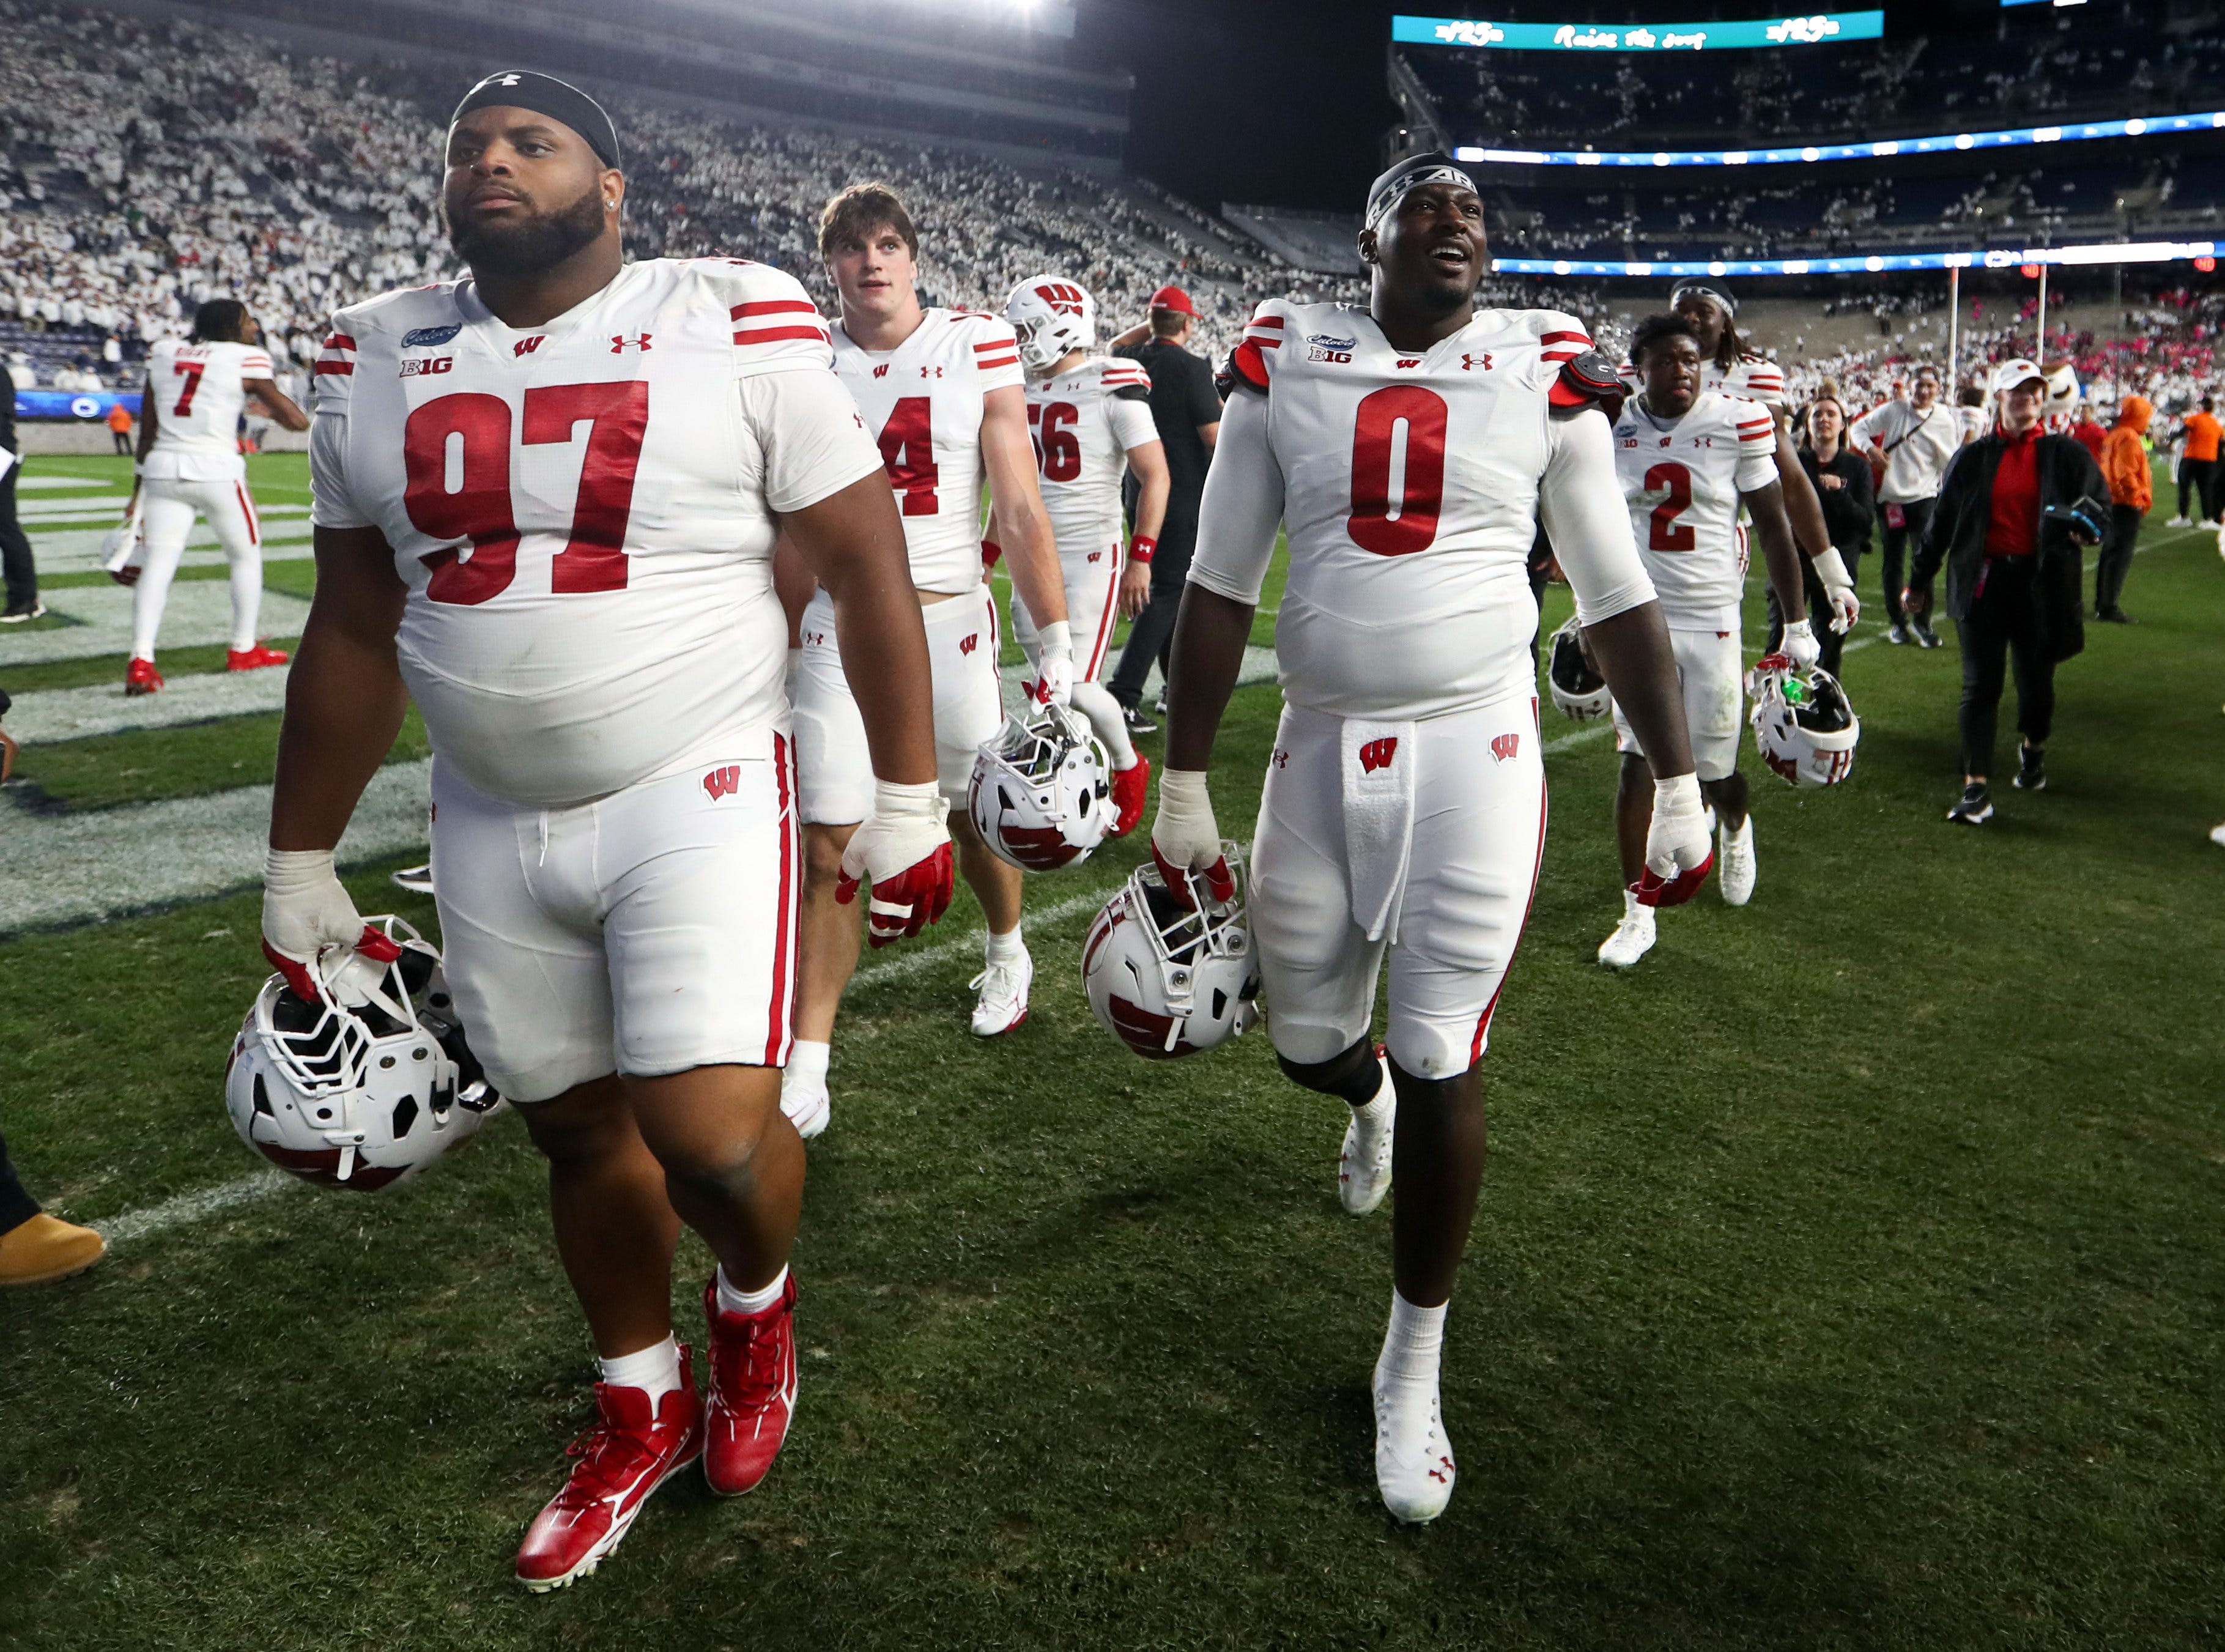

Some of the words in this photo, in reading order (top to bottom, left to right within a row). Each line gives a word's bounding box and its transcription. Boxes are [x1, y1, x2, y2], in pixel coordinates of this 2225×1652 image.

[514, 336, 546, 358] W
[1396, 360, 1420, 369] W
[174, 361, 204, 417] 7
[873, 364, 889, 379] W
[1347, 385, 1448, 557] 0
[404, 380, 648, 606] 97
[1644, 463, 1695, 551] 2
[960, 634, 977, 656] W
[1359, 737, 1398, 774] W
[1491, 734, 1519, 761] W
[704, 766, 740, 801] W
